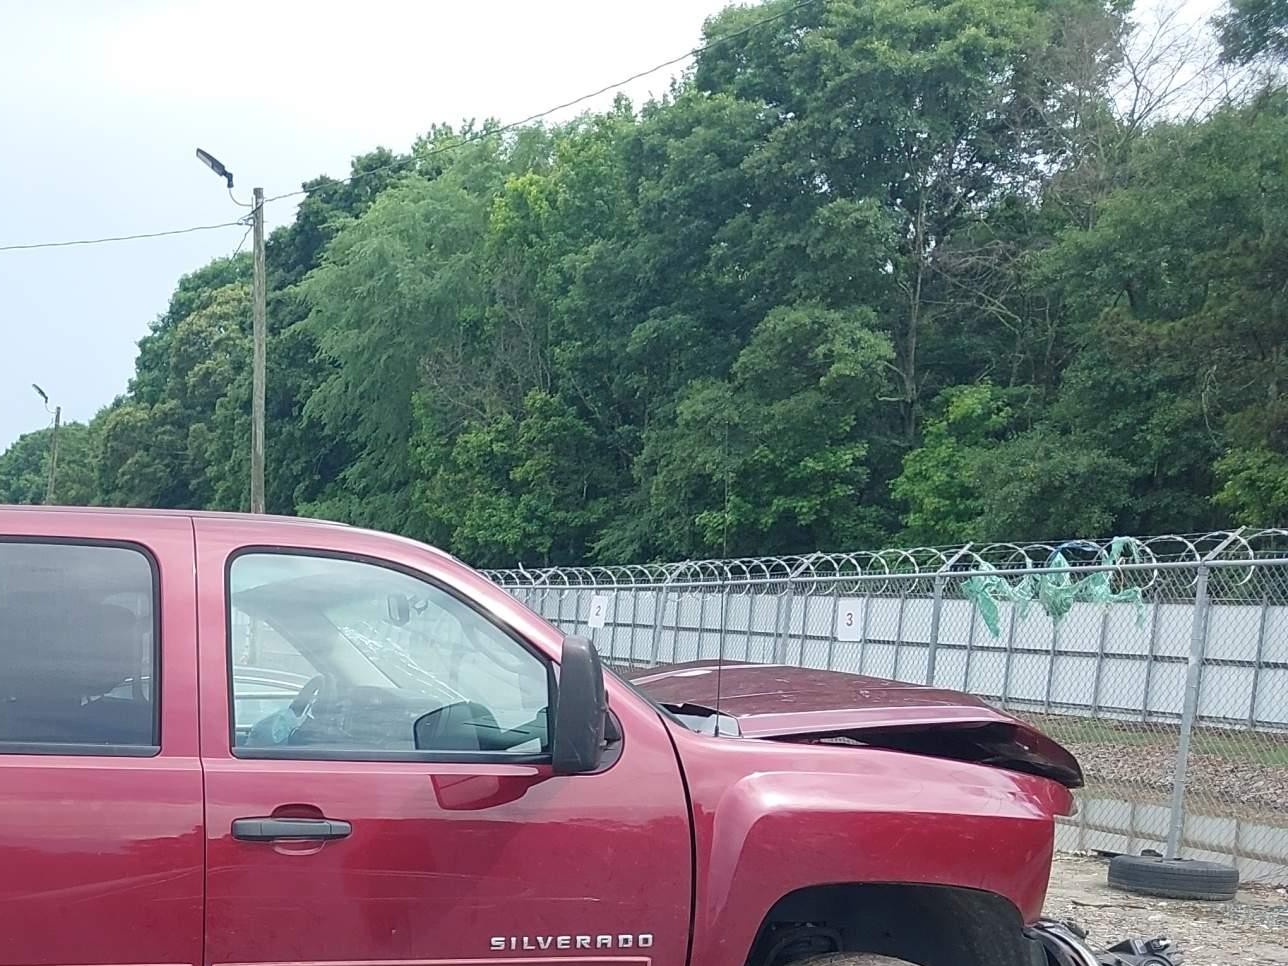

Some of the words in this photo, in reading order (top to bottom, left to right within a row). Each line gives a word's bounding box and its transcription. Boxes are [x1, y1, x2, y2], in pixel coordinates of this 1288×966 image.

[595, 605, 602, 617] 2
[846, 612, 854, 627] 3
[490, 934, 653, 950] SILVERADO
